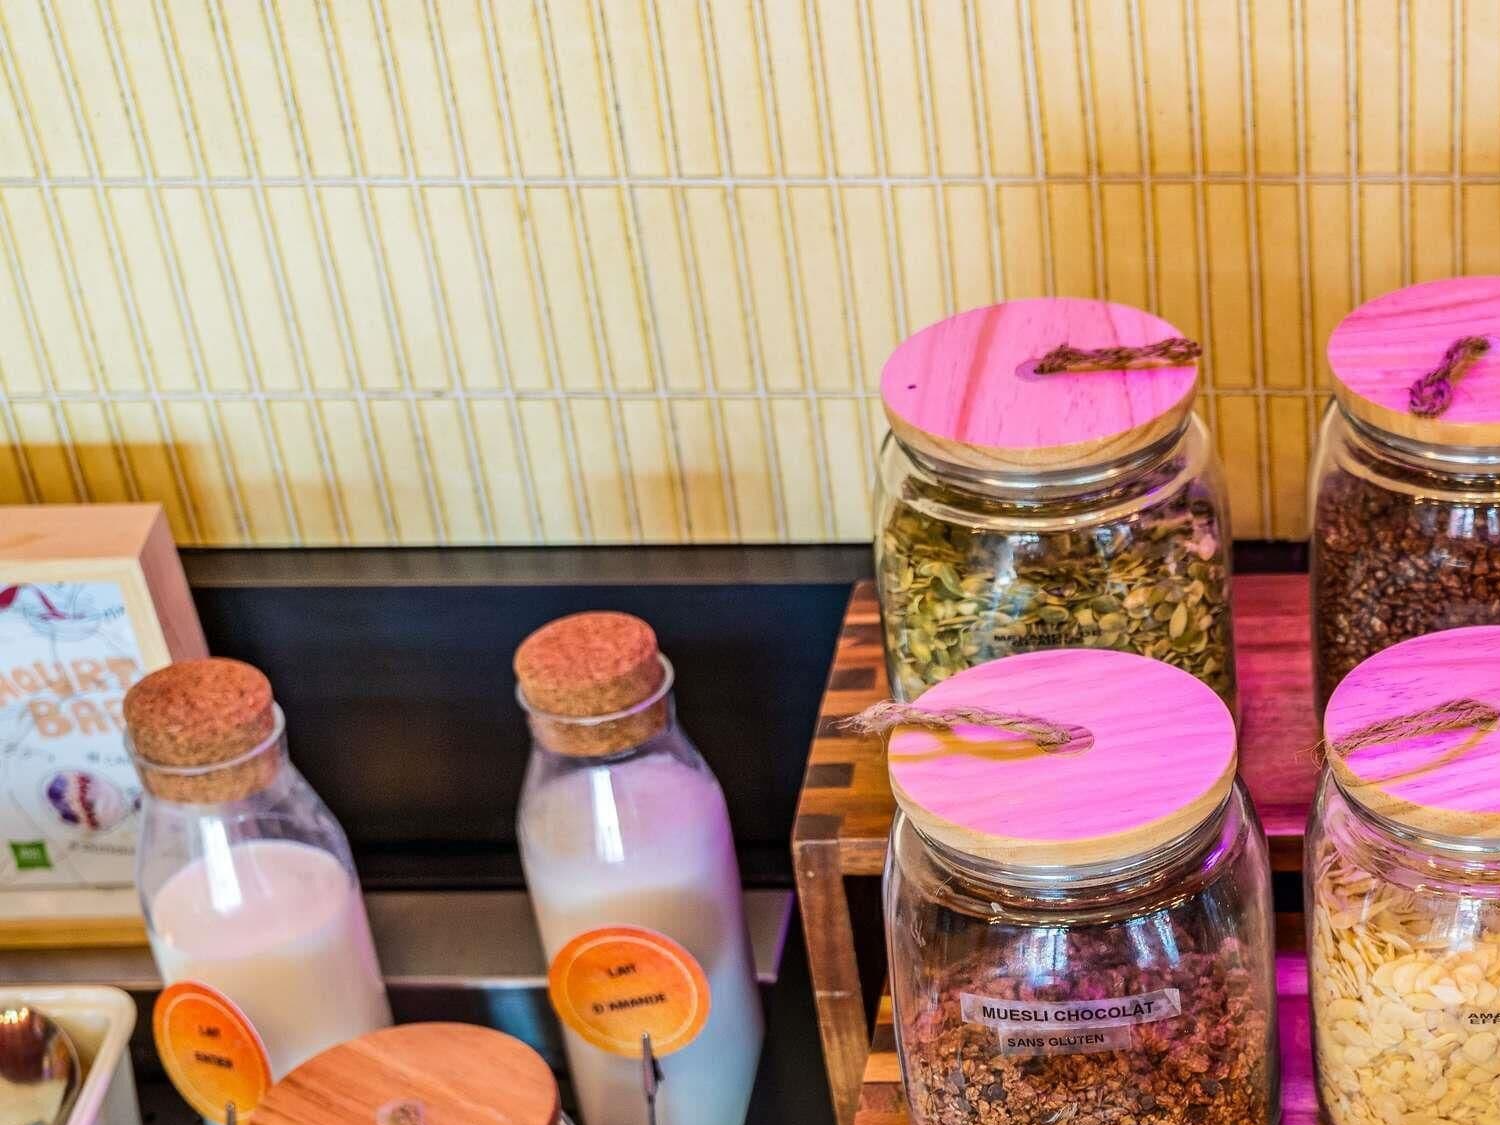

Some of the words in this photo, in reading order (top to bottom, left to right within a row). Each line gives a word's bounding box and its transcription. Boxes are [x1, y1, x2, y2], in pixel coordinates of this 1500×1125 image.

[982, 1005, 1049, 1023] MUESLI
[1054, 1001, 1155, 1022] CHOCOLAT
[1007, 1037, 1045, 1048] SANS
[1048, 1034, 1105, 1048] GLUTEN
